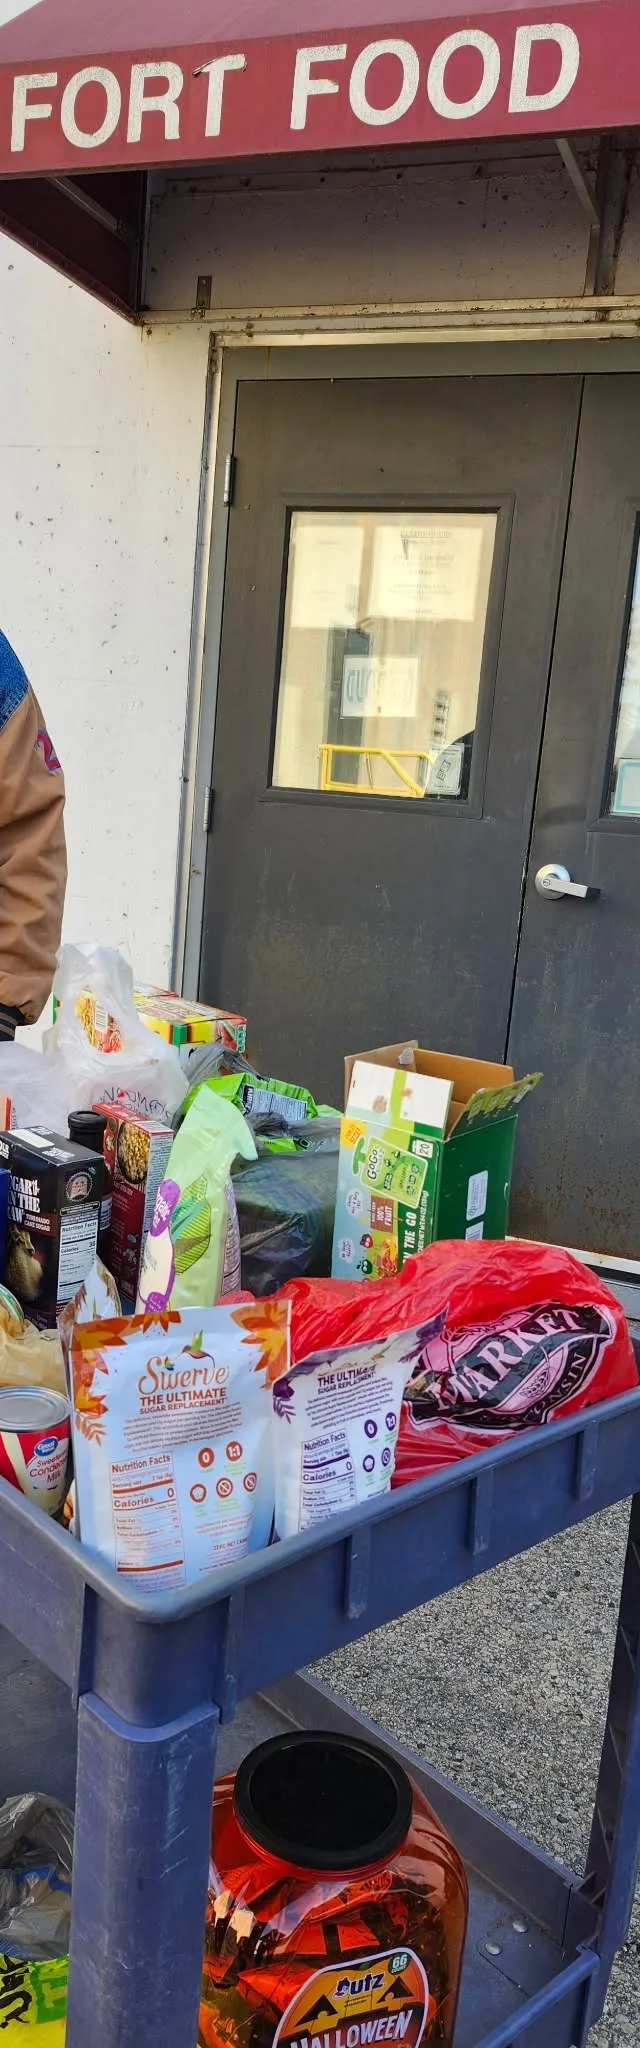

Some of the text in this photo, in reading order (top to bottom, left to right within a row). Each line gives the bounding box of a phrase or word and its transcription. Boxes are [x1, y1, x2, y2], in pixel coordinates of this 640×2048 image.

[10, 22, 581, 153] FORT FOOD
[419, 1143, 430, 1158] 20
[18, 1193, 41, 1213] THE
[384, 1206, 393, 1226] FRUIT
[405, 1211, 417, 1227] GO
[403, 1230, 416, 1249] THE
[424, 1308, 586, 1411] MARKET
[137, 1356, 229, 1395] Swerve
[317, 1375, 335, 1388] THE
[140, 1387, 227, 1407] THE ULTIMATE
[317, 1384, 337, 1395] SUGAR
[140, 1398, 227, 1415] SUGAR REPLACEMENT
[304, 1432, 346, 1451] Nutrition Facts
[112, 1454, 171, 1473] Nutrition Facts
[345, 1461, 353, 1471] 0
[47, 1471, 61, 1483] Milk
[302, 1471, 337, 1481] Calories
[167, 1487, 175, 1498] 0
[114, 1496, 154, 1508] Calories
[392, 1954, 408, 1968] 66
[290, 2009, 413, 2048] HALLOWEEN
